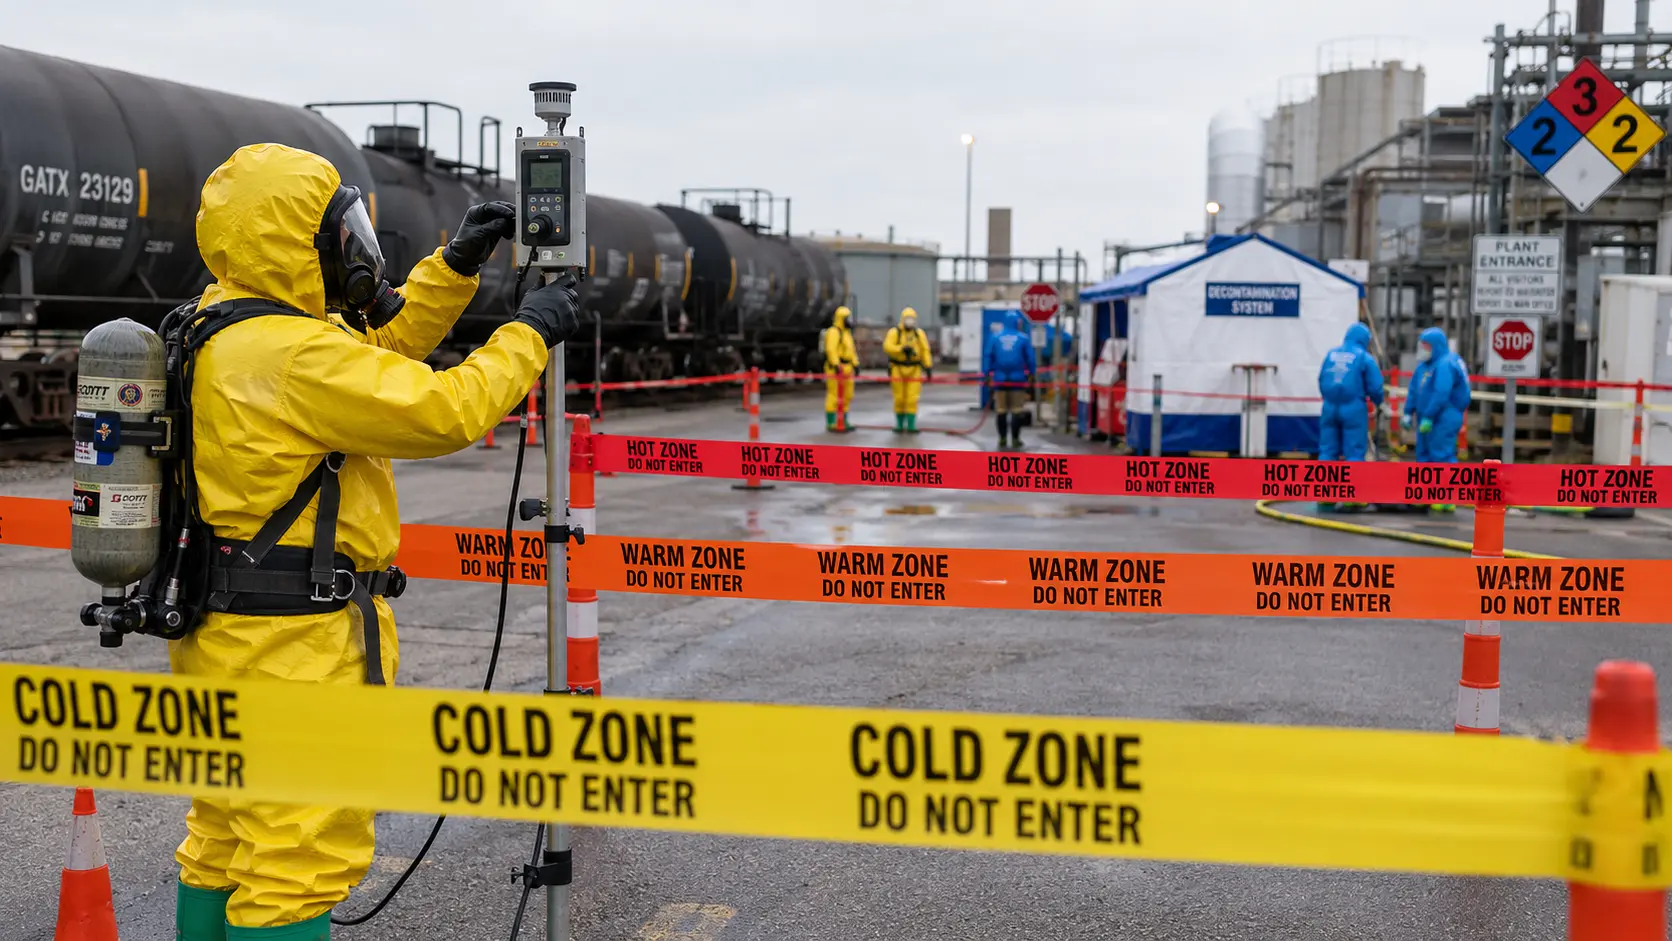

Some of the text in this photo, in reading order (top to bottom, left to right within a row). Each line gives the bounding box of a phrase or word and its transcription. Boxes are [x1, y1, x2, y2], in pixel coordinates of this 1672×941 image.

[1572, 76, 1597, 116] 3
[1531, 117, 1556, 155] 2
[1612, 114, 1638, 154] 2
[20, 164, 134, 204] GATX 23129
[1496, 241, 1539, 253] PLANT
[1480, 255, 1554, 268] ENTRANCE
[1489, 275, 1544, 284] ALL VISITORS
[1208, 285, 1298, 299] DECONTAMINATION
[1023, 294, 1057, 312] STOP
[1231, 300, 1273, 314] SYSTEM
[1494, 332, 1533, 350] STOP
[627, 440, 698, 459] HOT ZONE
[742, 446, 814, 464] HOT ZONE
[628, 458, 703, 472] DO NOT ENTER
[861, 452, 937, 470] HOT ZONE
[988, 456, 1068, 475] HOT ZONE
[1127, 461, 1209, 479] HOT ZONE
[742, 464, 819, 479] DO NOT ENTER
[861, 470, 942, 484] DO NOT ENTER
[1265, 464, 1350, 482] HOT ZONE
[1408, 467, 1497, 486] HOT ZONE
[1561, 469, 1653, 488] HOT ZONE
[988, 475, 1072, 489] DO NOT ENTER
[1126, 480, 1214, 494] DO NOT ENTER
[1262, 484, 1355, 498] DO NOT ENTER
[1405, 487, 1501, 502] DO NOT ENTER
[1558, 490, 1657, 503] DO NOT ENTER
[520, 536, 571, 561] ZO
[621, 543, 745, 570] WARM ZONE
[461, 559, 481, 576] DO
[522, 562, 570, 582] ENT
[817, 552, 948, 577] WARM ZONE
[1029, 557, 1165, 583] WARM ZONE
[627, 570, 742, 592] DO NOT ENTER
[1252, 562, 1394, 588] WARM ZONE
[1476, 566, 1624, 591] WARM ZONE
[823, 579, 945, 600] DO NOT ENTER
[1034, 586, 1162, 606] DO NOT ENTER
[1257, 592, 1390, 612] DO NOT ENTER
[1481, 596, 1620, 616] DO NOT ENTER
[14, 676, 241, 740] COLD ZONE
[433, 703, 696, 767] COLD ZONE
[19, 736, 244, 788] DO NOT ENTER
[851, 724, 1141, 791] COLD ZONE
[440, 766, 694, 818] DO NOT ENTER
[859, 791, 1140, 844] DO NOT ENTER
